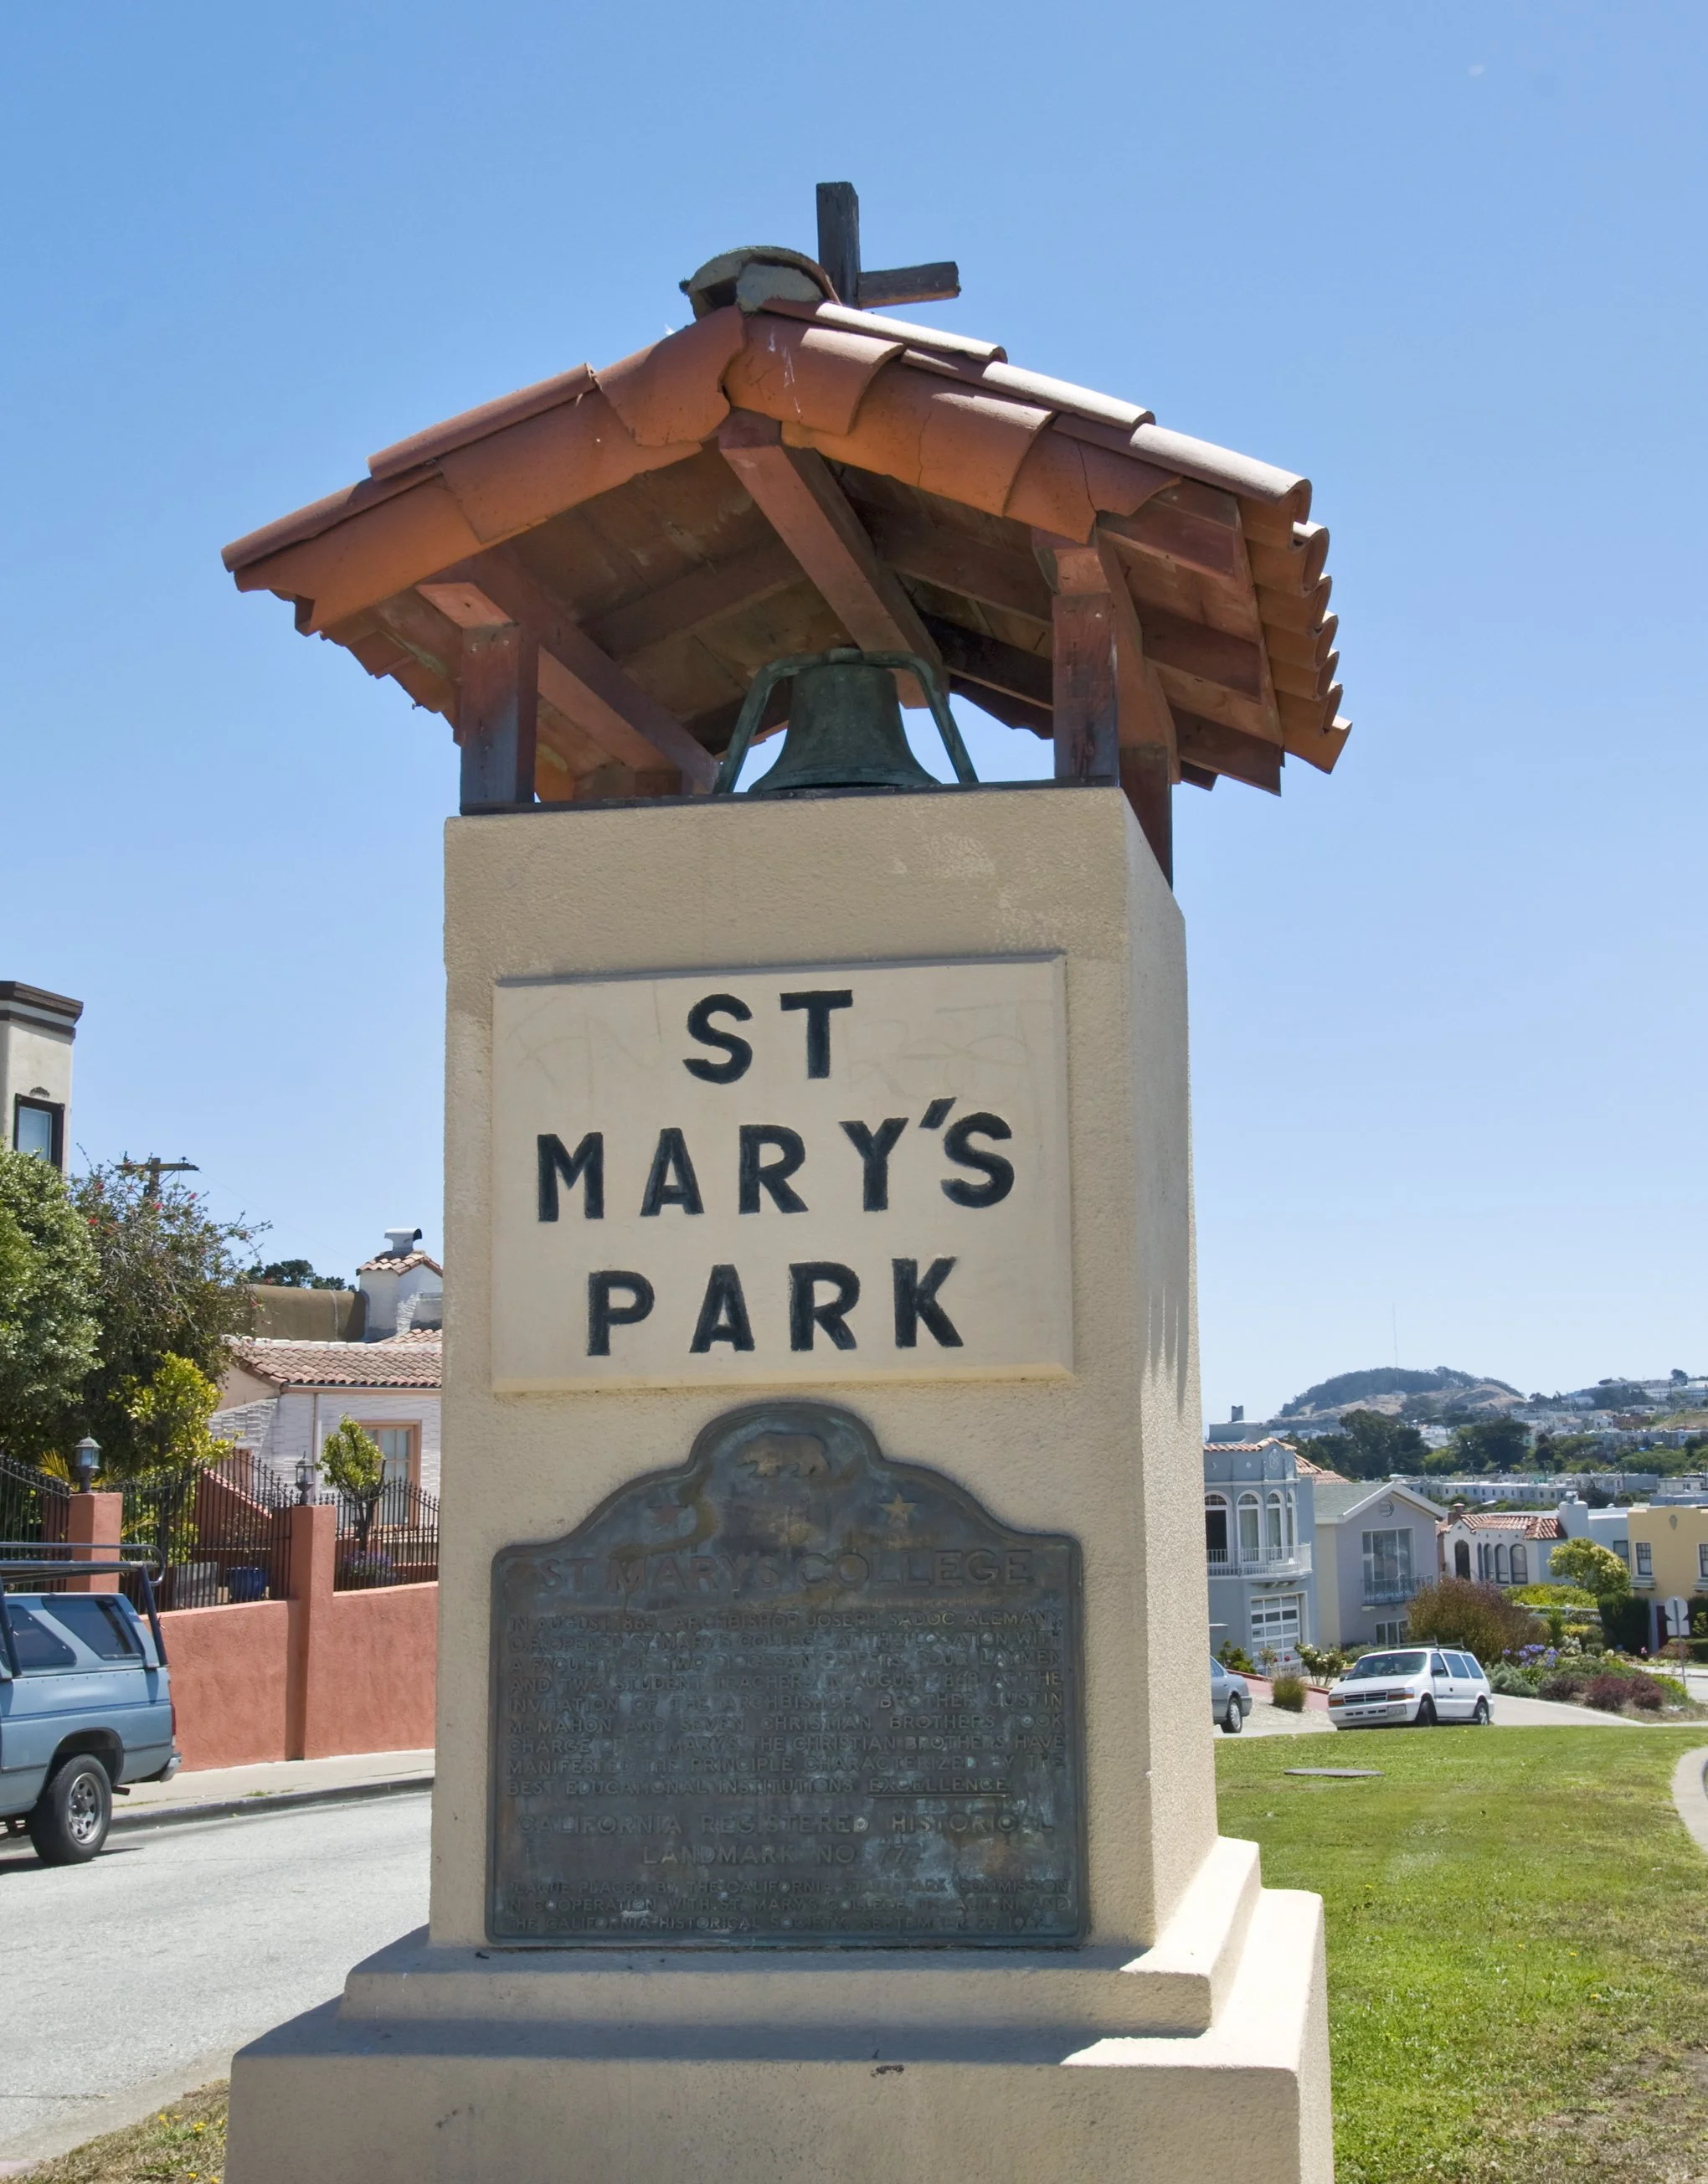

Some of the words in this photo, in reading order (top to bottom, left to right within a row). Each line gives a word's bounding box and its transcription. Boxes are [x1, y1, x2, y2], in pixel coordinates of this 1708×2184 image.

[682, 989, 853, 1084] ST
[537, 1097, 1015, 1223] MARY'S
[587, 1256, 964, 1357] PARK
[795, 1548, 1037, 1589] COLLEGE
[808, 1612, 877, 1629] JOSEPH
[889, 1611, 956, 1627] SADOC
[980, 1651, 1062, 1666] LAYMEN
[510, 1677, 551, 1692] AND
[559, 1677, 604, 1691] TWO
[614, 1675, 703, 1691] STUDENT
[508, 1697, 620, 1713] INVITATION
[630, 1697, 657, 1712] OF
[990, 1692, 1062, 1708] JUSTIN
[625, 1718, 665, 1733] AND
[679, 1718, 744, 1733] SEVEN
[760, 1716, 872, 1732] CHRISTIAN
[889, 1714, 995, 1730] BROTHERS
[508, 1738, 591, 1754] CHARGE
[749, 1737, 785, 1752] THE
[793, 1736, 897, 1751] CHRISTIAN
[904, 1735, 1006, 1750] BROTHERS
[1014, 1734, 1065, 1749] HAVE
[508, 1759, 635, 1775] MANIFESTED
[690, 1757, 794, 1774] PRINCIPLE
[804, 1755, 977, 1772] CHARACTERIZED
[507, 1780, 555, 1796] BEST
[565, 1778, 709, 1795] EDUCATIONAL
[517, 1815, 683, 1835] CALIFORNIA
[700, 1814, 871, 1835] REGISTERED
[891, 1813, 1056, 1834] HISTORICAL
[642, 1844, 796, 1865] LANDMARK
[579, 1881, 646, 1896] PLACED
[727, 1880, 831, 1894] CALIFORNIA
[958, 1879, 1068, 1893] COMMISSION
[533, 1898, 656, 1913] COOPERATION
[667, 1898, 710, 1912] WITH
